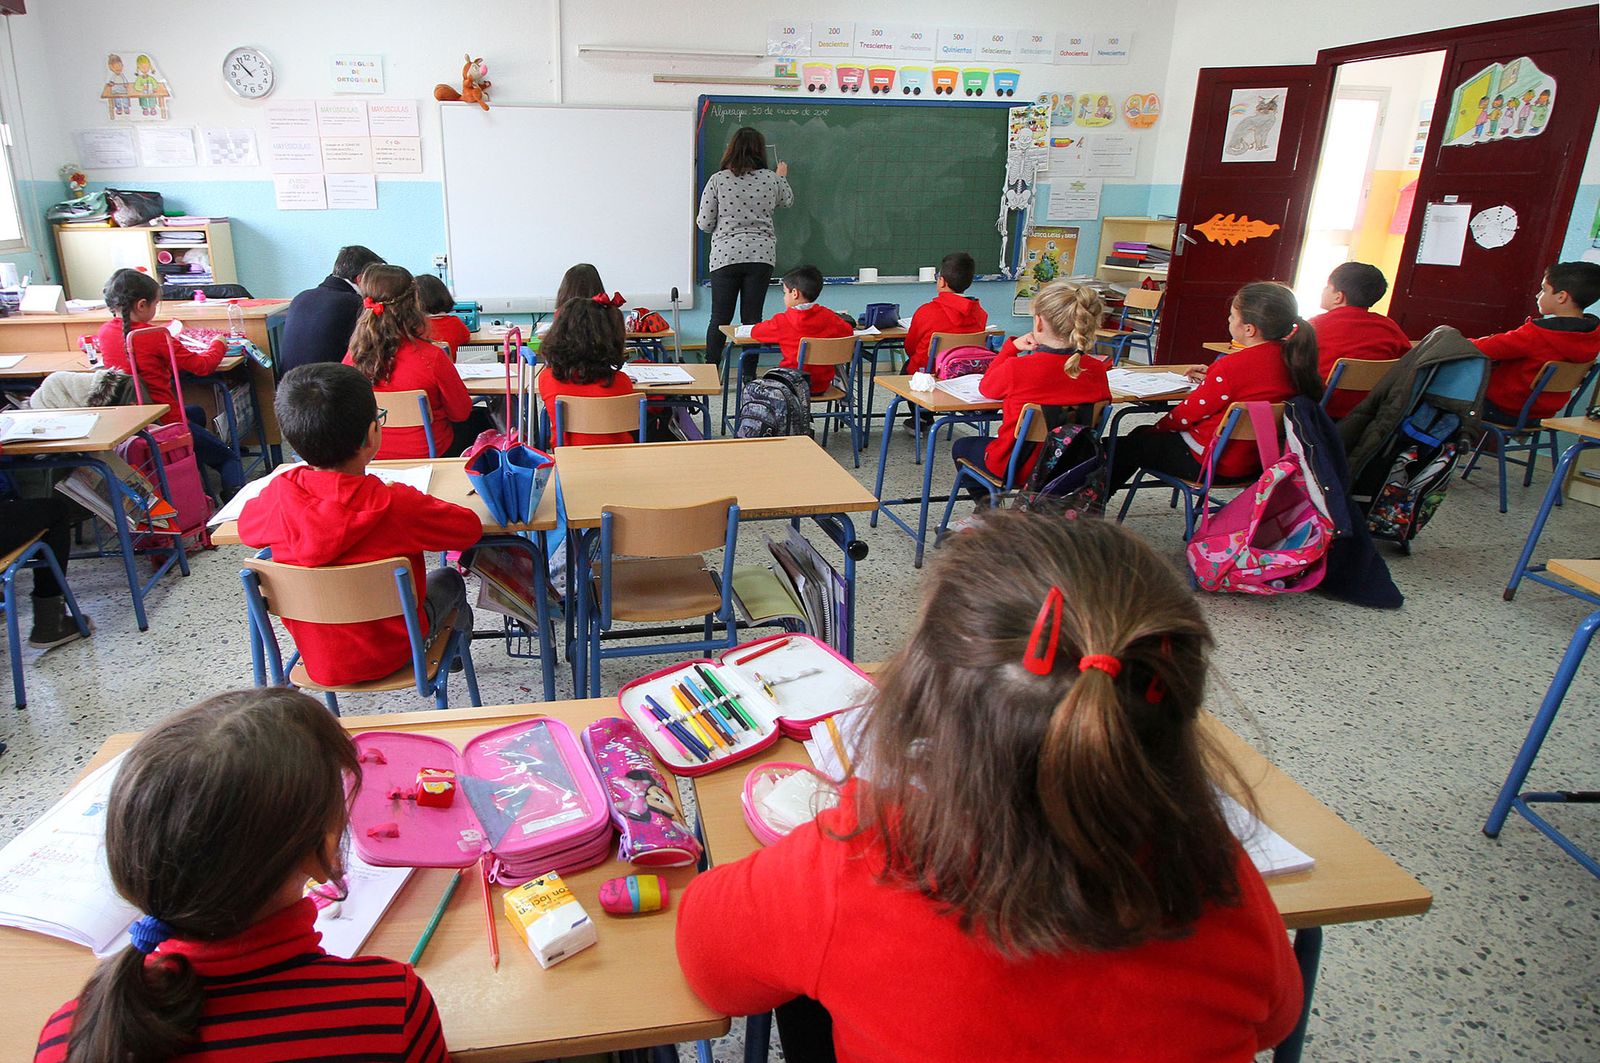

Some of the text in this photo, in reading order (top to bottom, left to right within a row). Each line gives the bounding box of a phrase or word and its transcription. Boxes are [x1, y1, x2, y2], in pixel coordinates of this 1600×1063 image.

[783, 27, 796, 35] 100
[828, 27, 841, 35] 200
[952, 33, 964, 41] 500
[859, 42, 892, 50] Trescientos
[942, 46, 973, 55] Quinientos
[232, 63, 241, 71] 10
